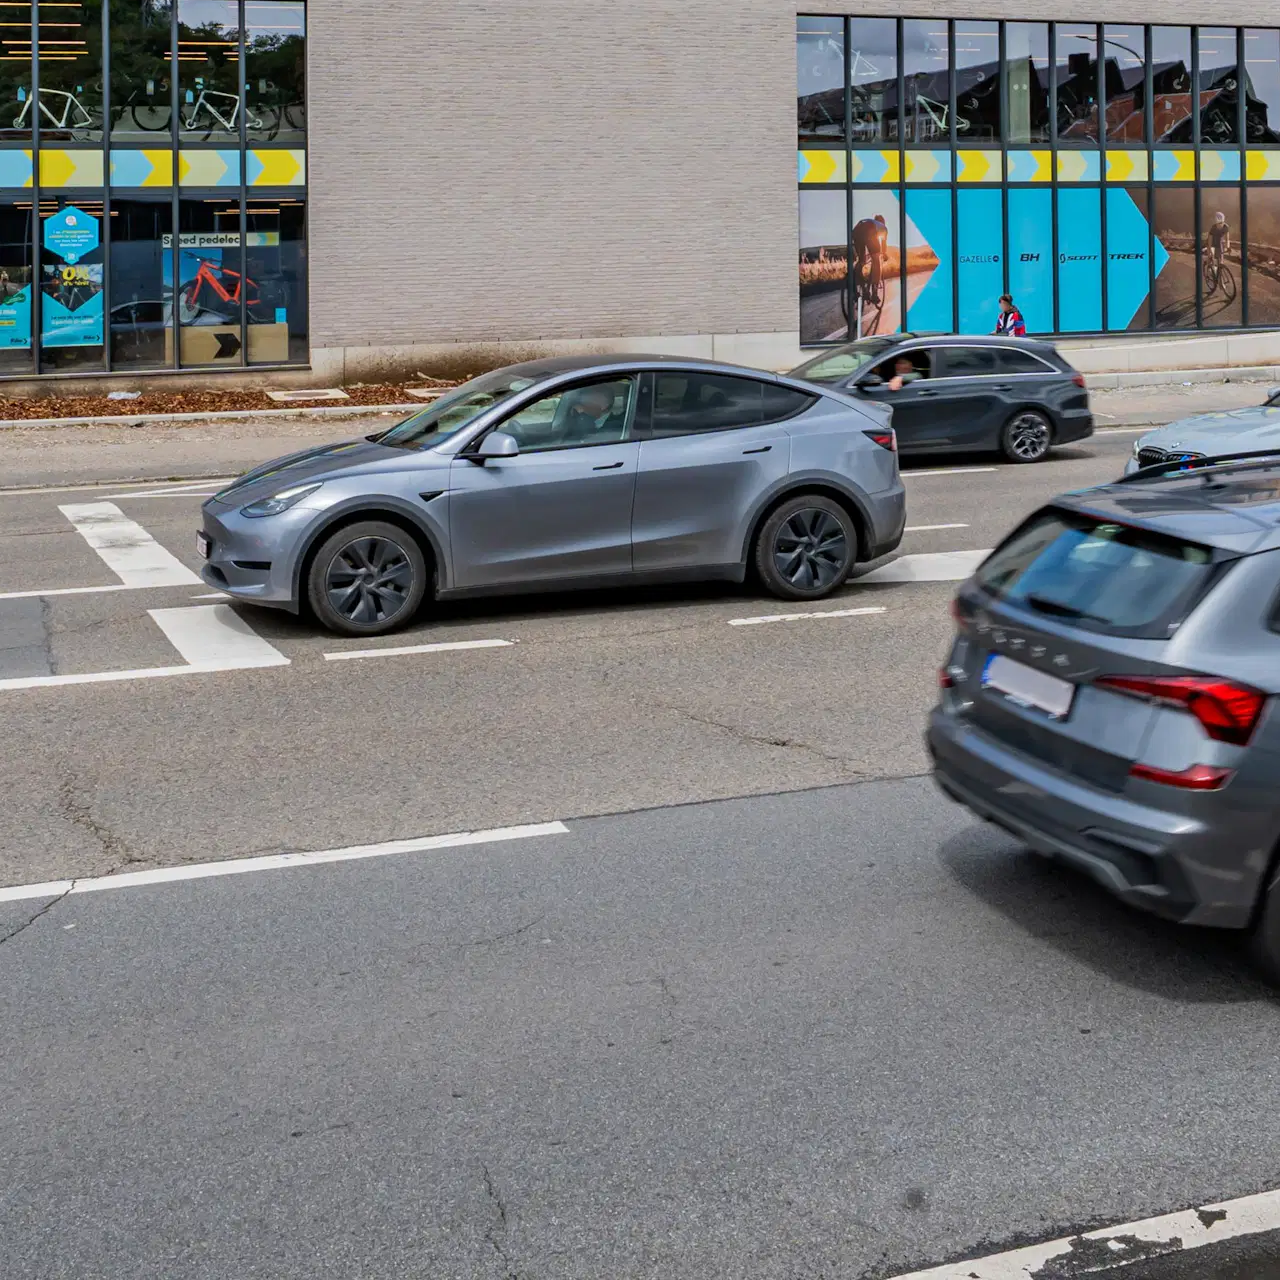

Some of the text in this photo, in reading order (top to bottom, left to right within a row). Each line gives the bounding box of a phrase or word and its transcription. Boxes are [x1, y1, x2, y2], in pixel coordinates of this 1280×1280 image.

[163, 235, 240, 247] Seed pedelec
[959, 255, 993, 263] GAZELLE
[1020, 253, 1040, 262] BH
